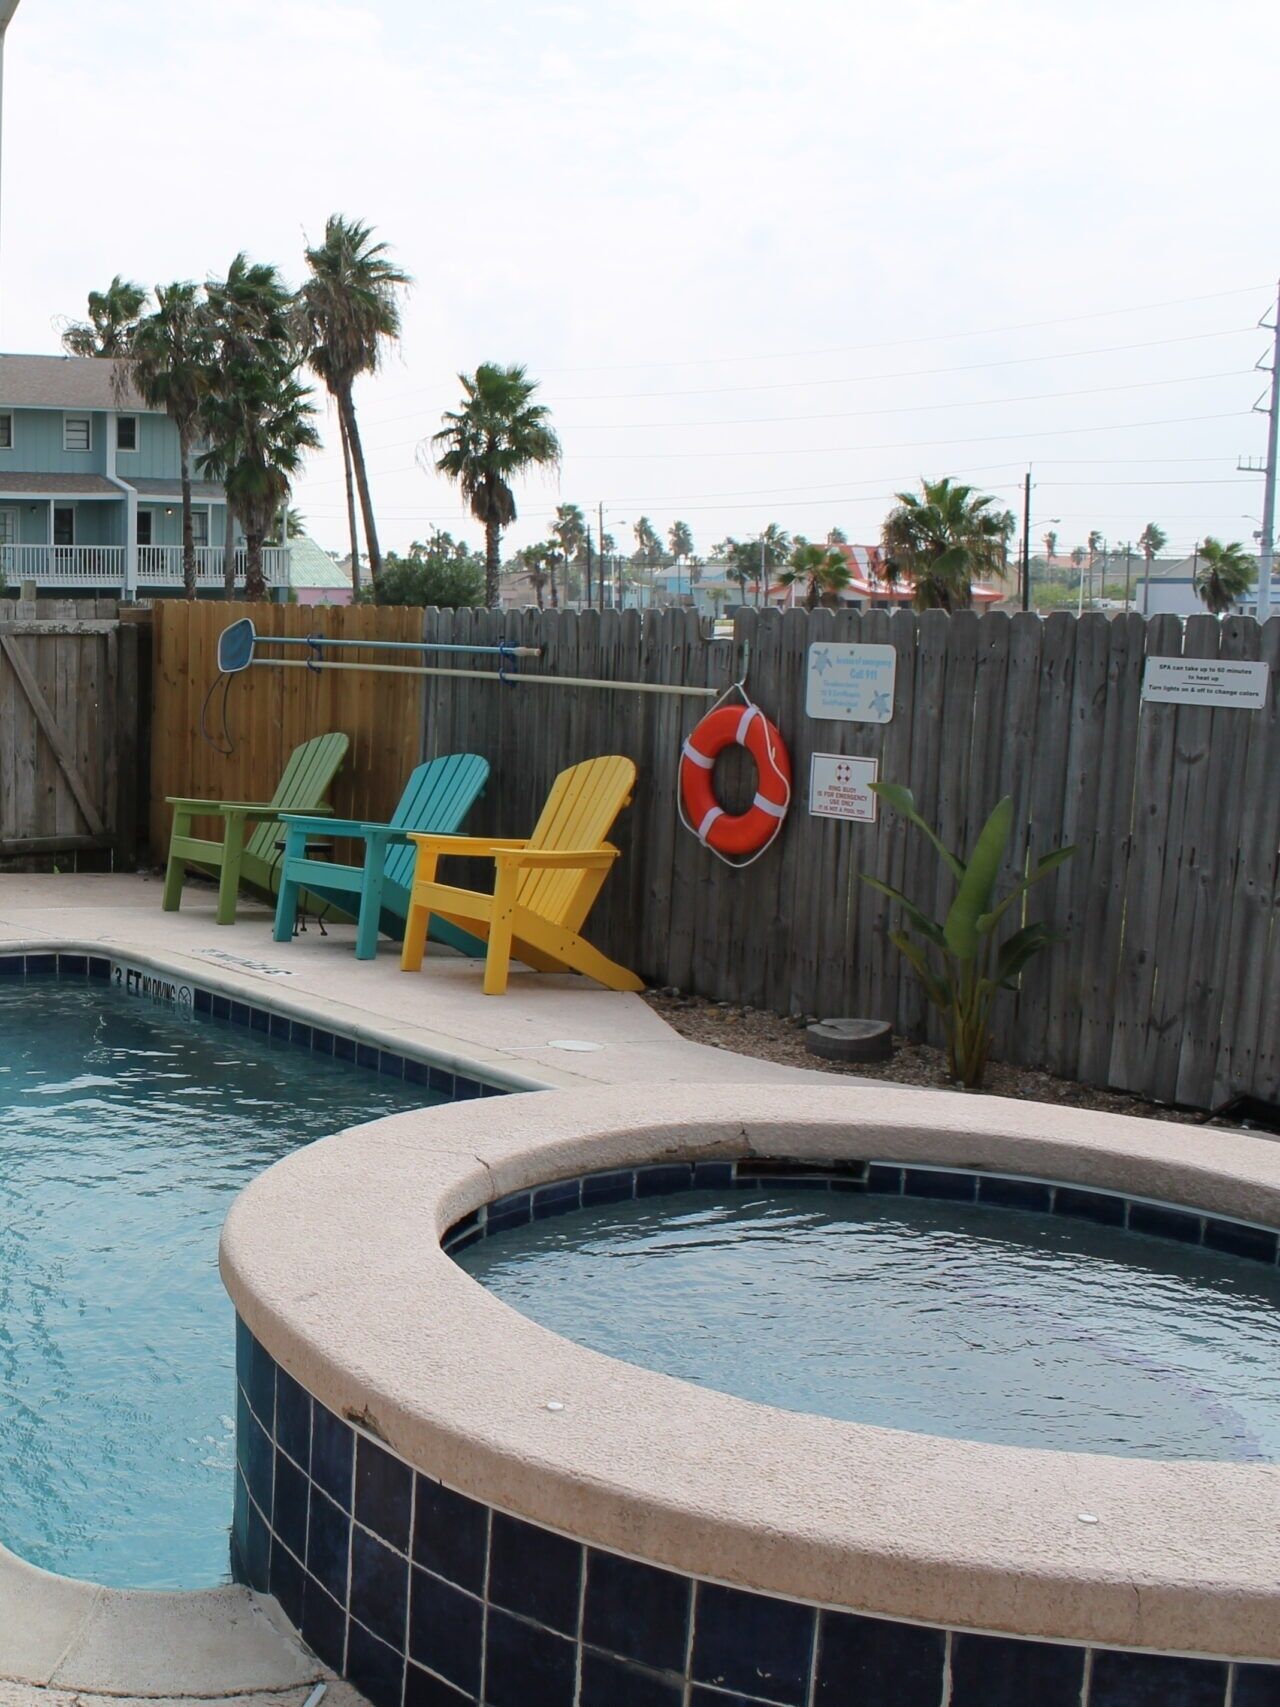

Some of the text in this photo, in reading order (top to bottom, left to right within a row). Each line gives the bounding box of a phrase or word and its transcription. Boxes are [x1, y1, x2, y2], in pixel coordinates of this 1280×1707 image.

[850, 668, 877, 680] Call 911
[836, 793, 867, 801] EMERGENCY
[115, 967, 122, 985] 3
[143, 975, 151, 992] NO
[152, 978, 175, 1002] DIVING
